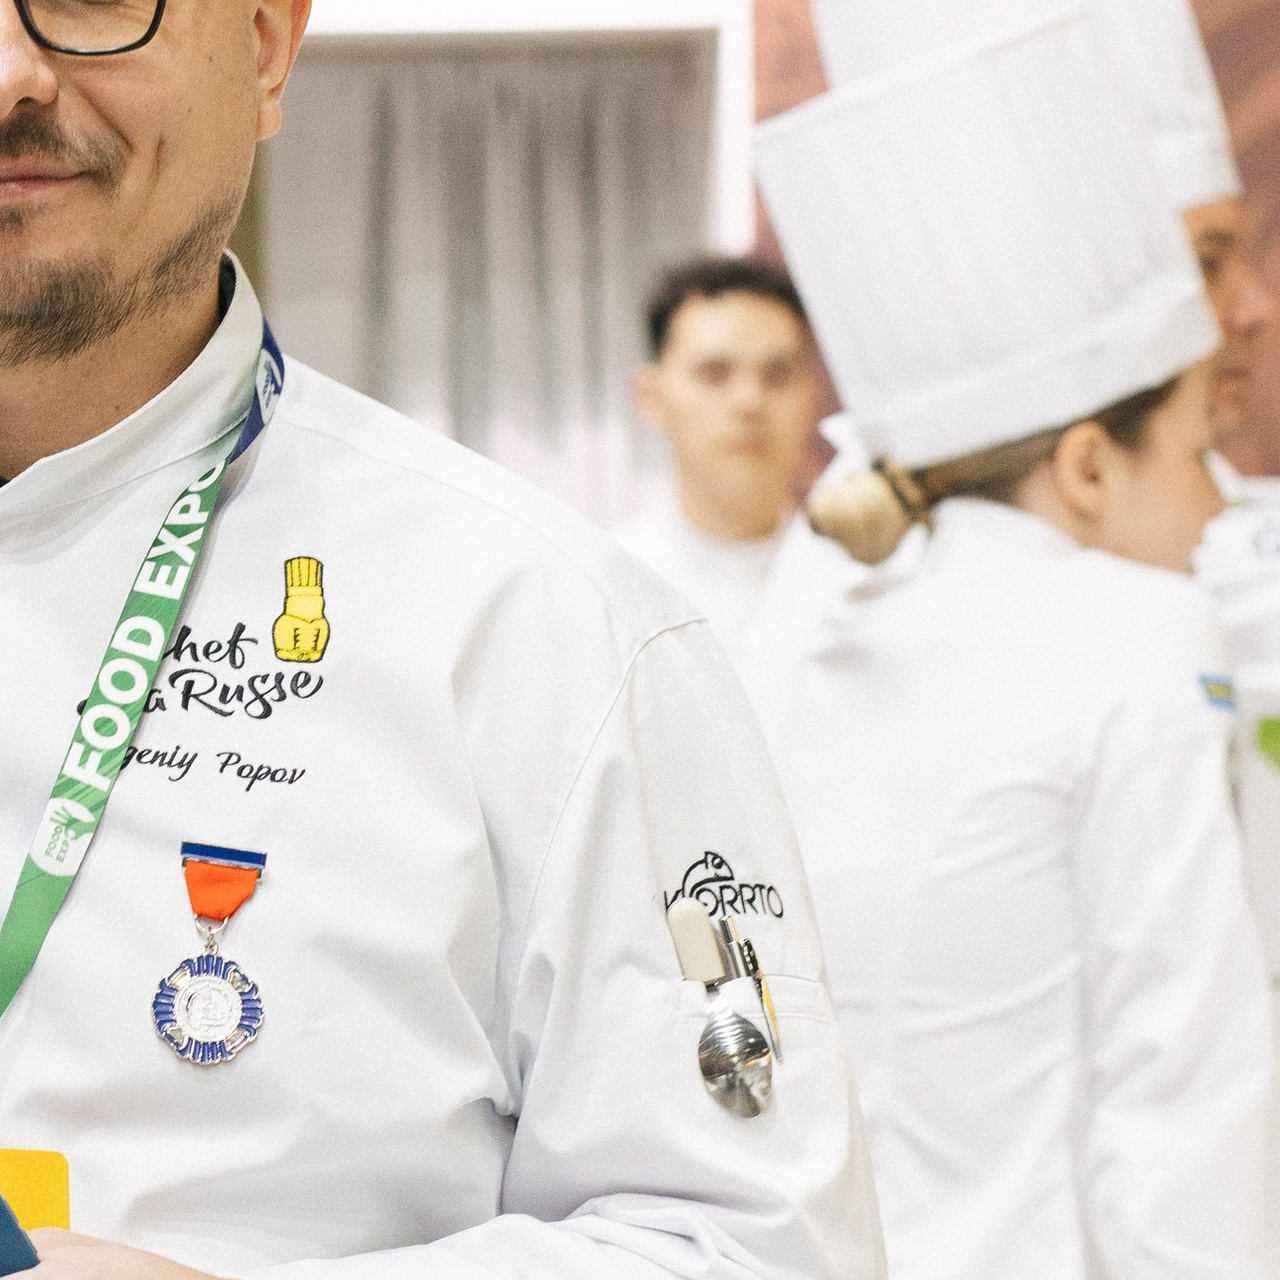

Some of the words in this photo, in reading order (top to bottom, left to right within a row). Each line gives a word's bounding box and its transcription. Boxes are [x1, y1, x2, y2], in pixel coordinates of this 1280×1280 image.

[161, 622, 259, 670] hef
[62, 615, 166, 792] FOOD
[168, 668, 324, 720] Russe
[216, 751, 307, 792] Popov
